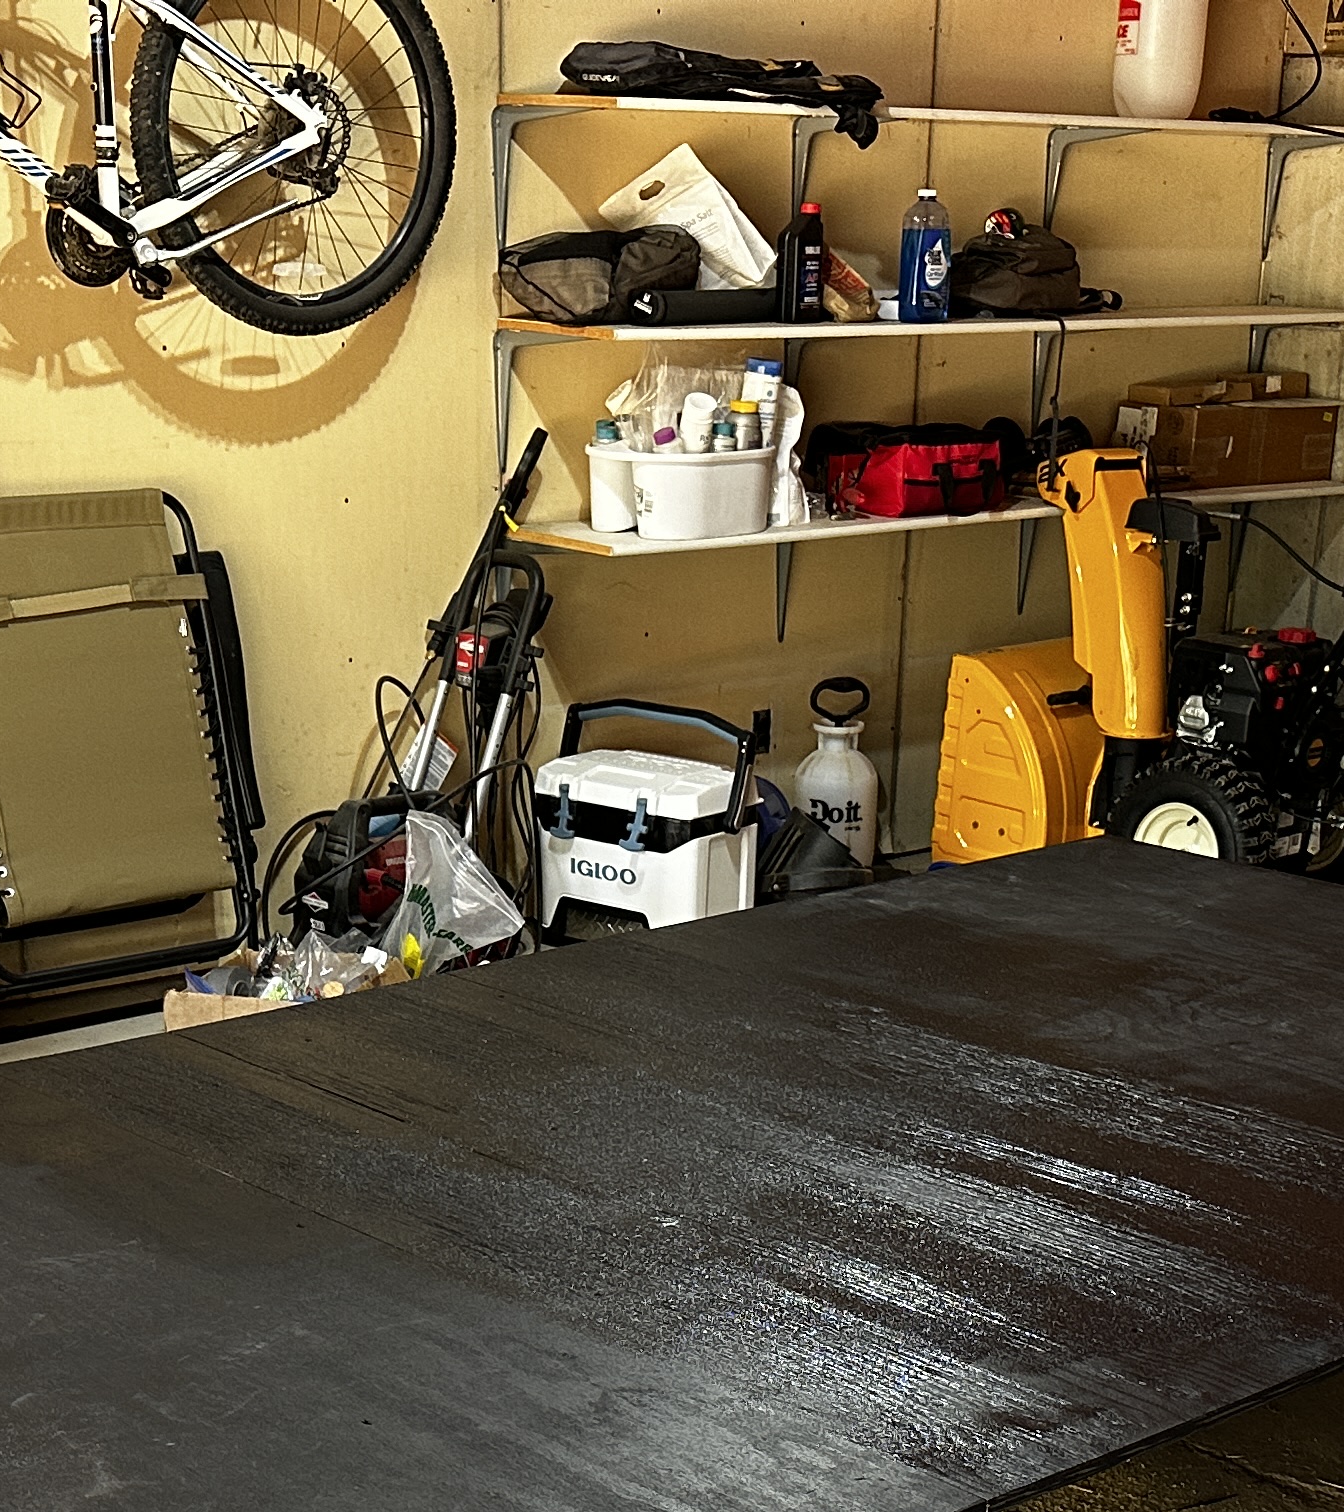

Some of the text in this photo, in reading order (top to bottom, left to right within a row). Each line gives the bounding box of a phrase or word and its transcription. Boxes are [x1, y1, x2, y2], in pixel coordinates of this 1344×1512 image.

[680, 208, 714, 229] Spa Salt
[844, 800, 863, 823] it
[570, 857, 637, 885] IGLOO
